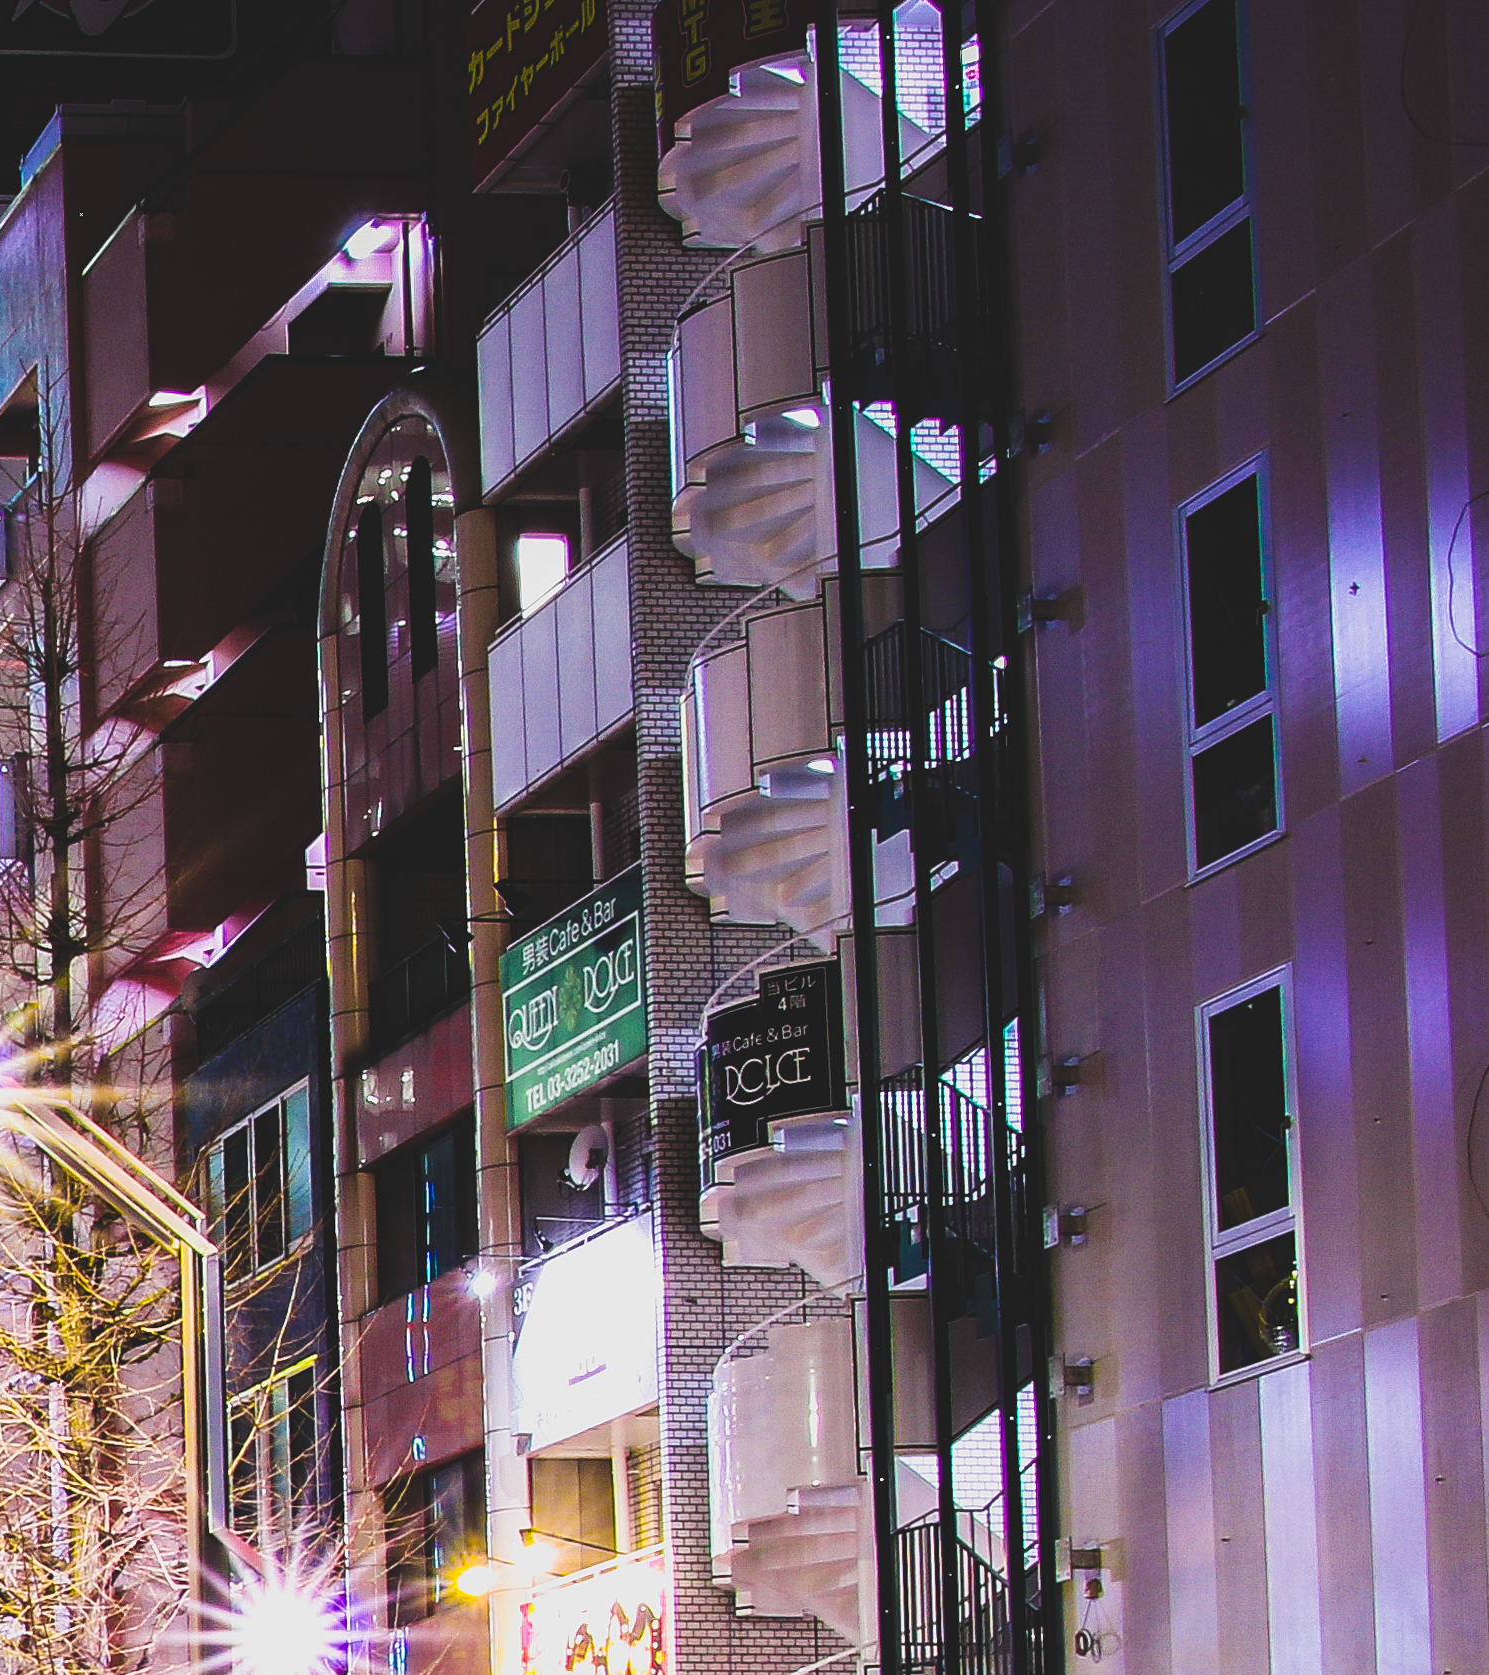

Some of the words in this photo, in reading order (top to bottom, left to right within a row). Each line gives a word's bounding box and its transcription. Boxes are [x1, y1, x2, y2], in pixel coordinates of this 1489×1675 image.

[584, 939, 634, 1013] DOLCE
[526, 1082, 547, 1113] TEL
[548, 1040, 620, 1099] 03-3252-2031
[724, 1048, 811, 1105] DOLCE
